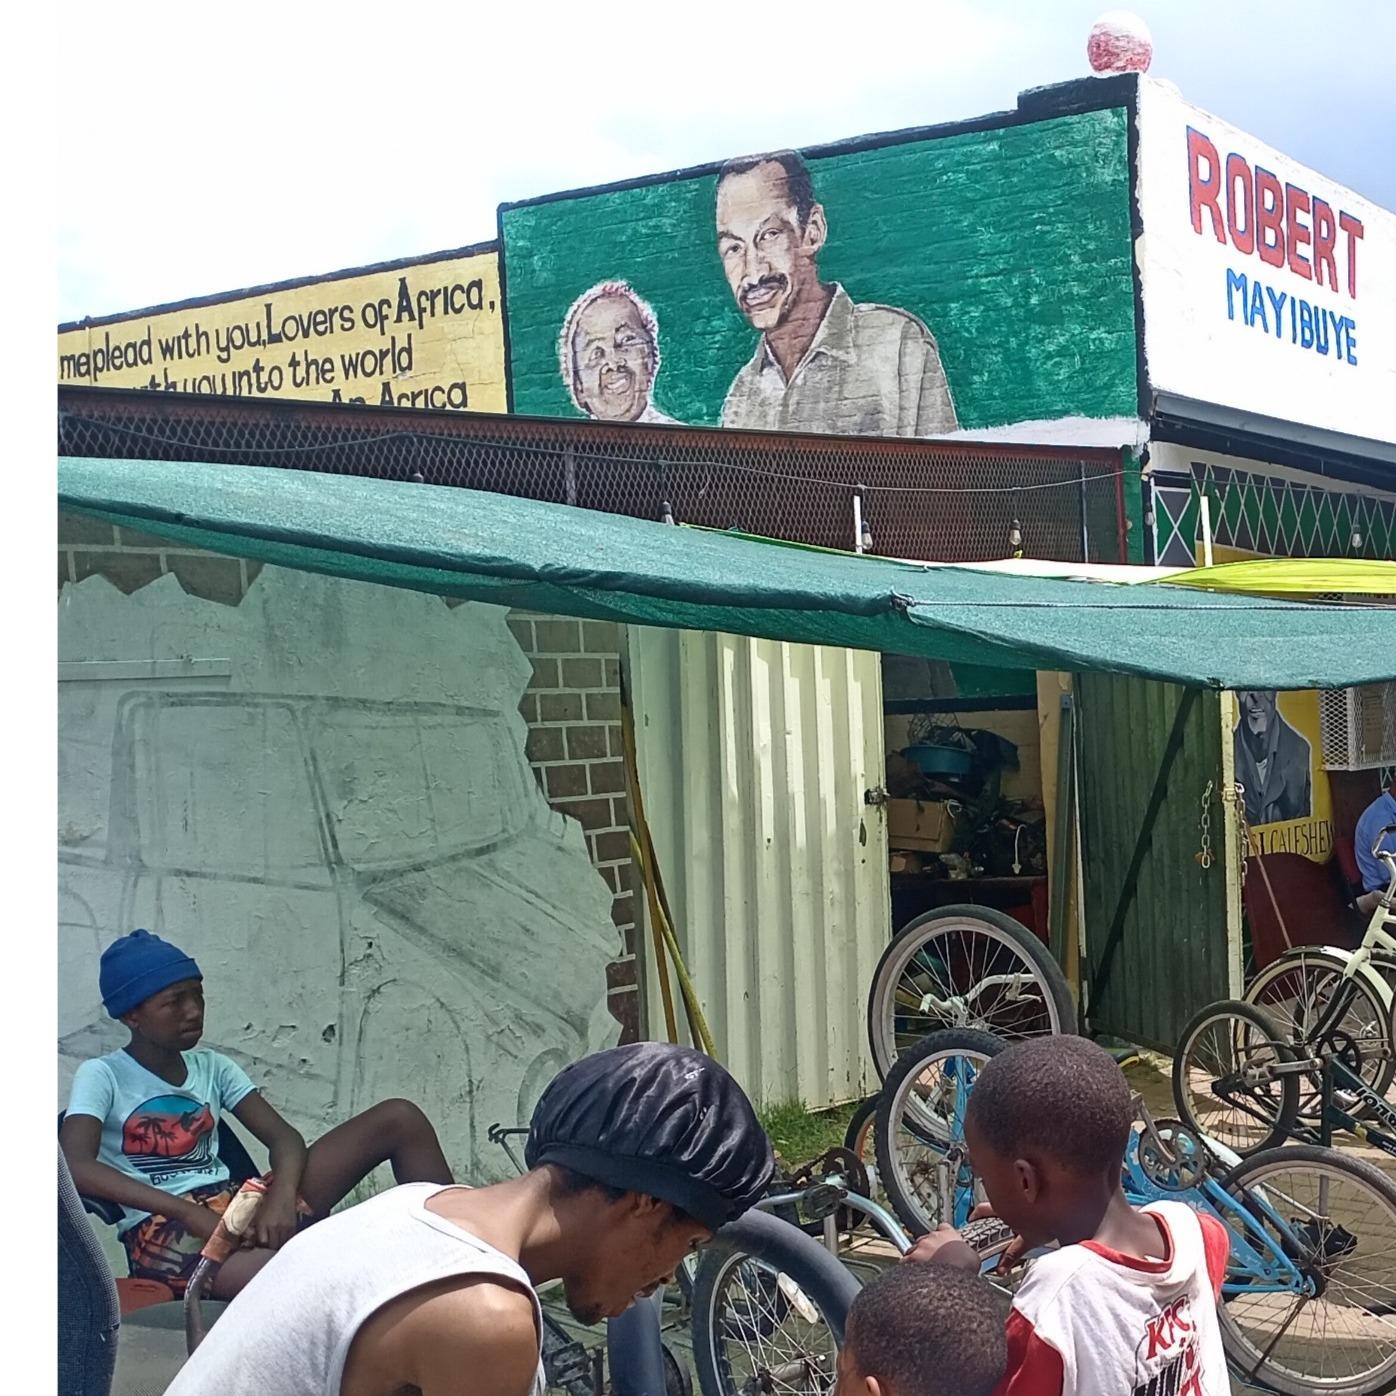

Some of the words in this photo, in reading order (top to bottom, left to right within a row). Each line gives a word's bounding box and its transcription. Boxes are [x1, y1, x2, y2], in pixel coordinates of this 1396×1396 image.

[1185, 125, 1364, 299] ROBERT
[158, 323, 210, 362] with
[361, 298, 392, 336] of
[1226, 268, 1358, 366] MAYIBUYE
[288, 350, 335, 388] the
[340, 333, 413, 381] world
[1145, 1297, 1192, 1361] KFC
